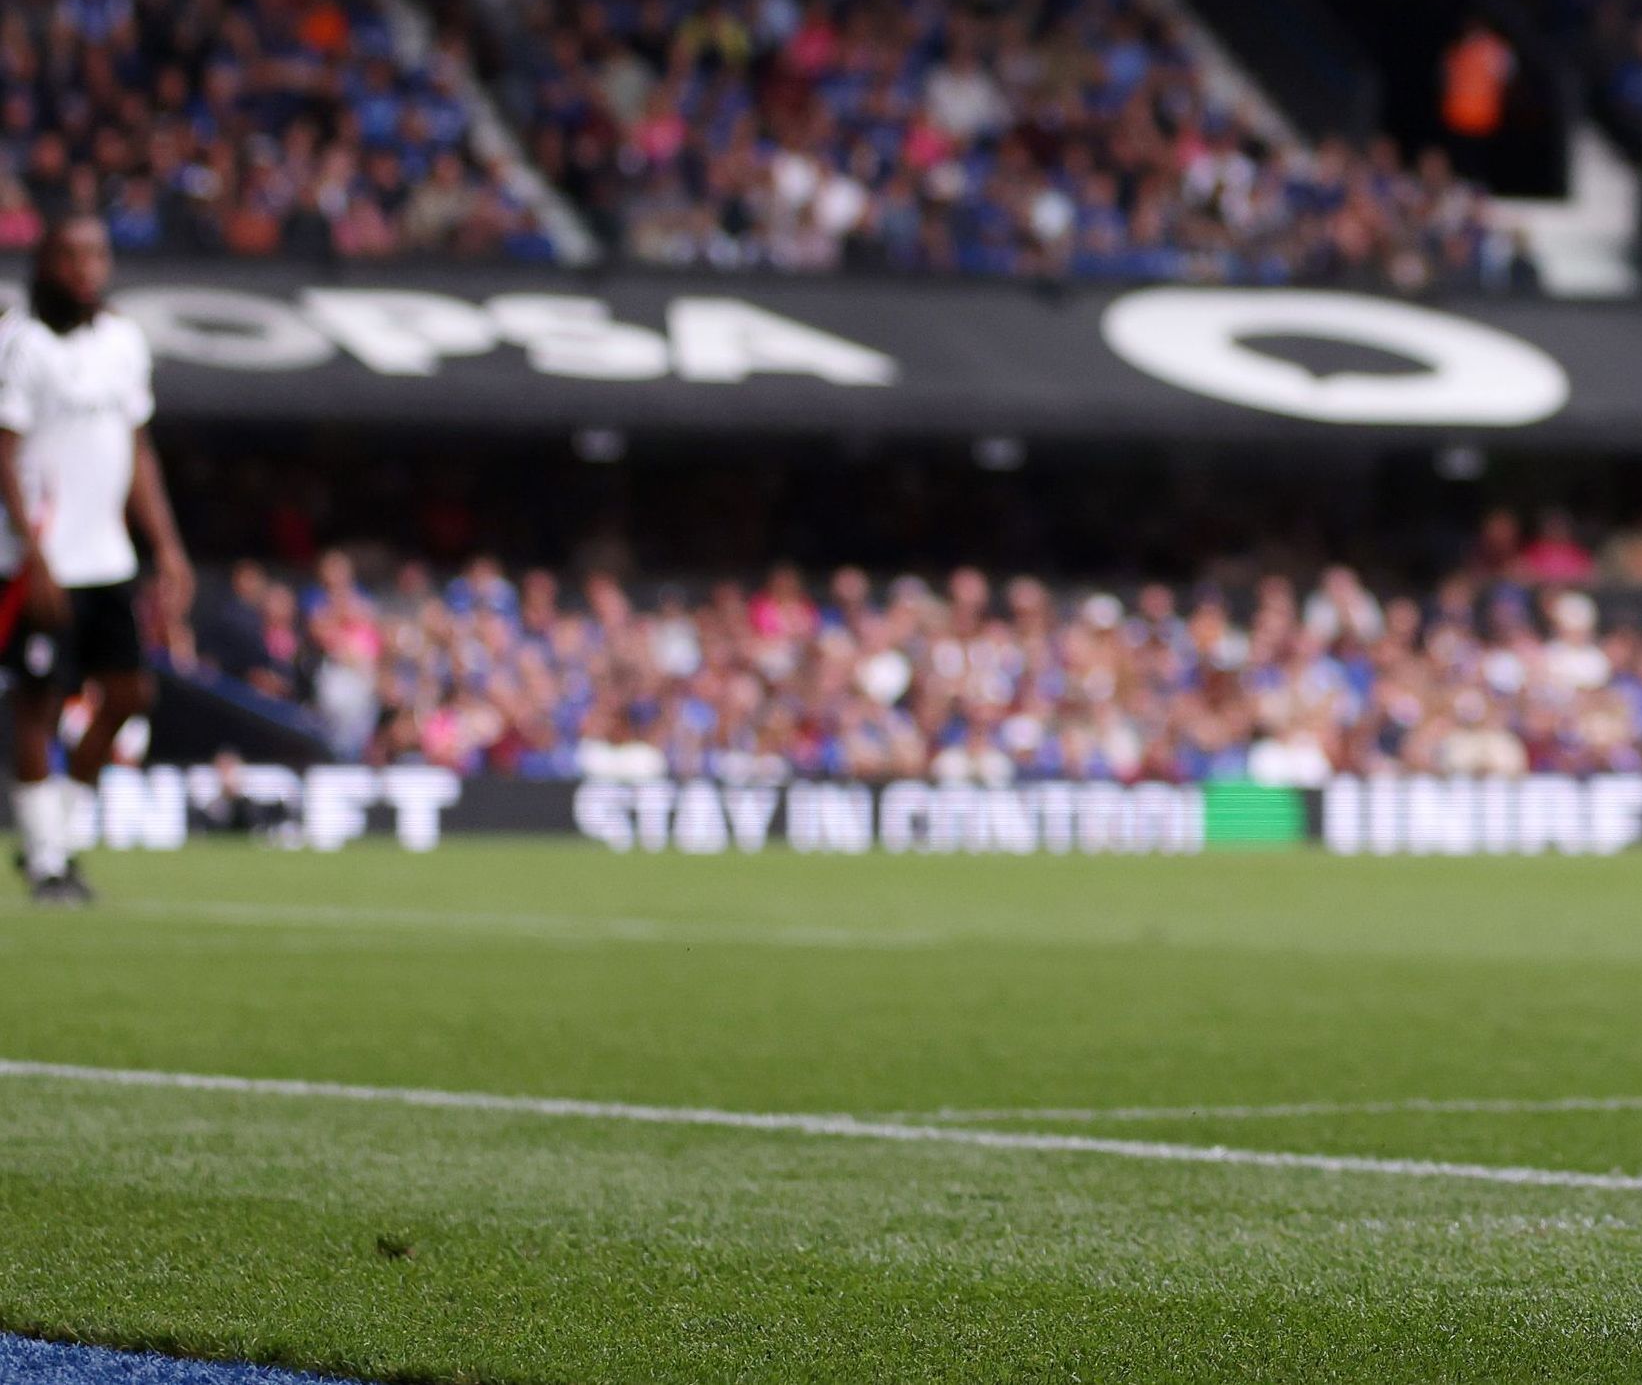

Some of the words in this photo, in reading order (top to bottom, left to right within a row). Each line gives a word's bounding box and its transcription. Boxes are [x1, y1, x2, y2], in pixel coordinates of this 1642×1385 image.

[98, 284, 903, 388] OPSA
[573, 780, 779, 855] STAY
[788, 780, 874, 856] IN
